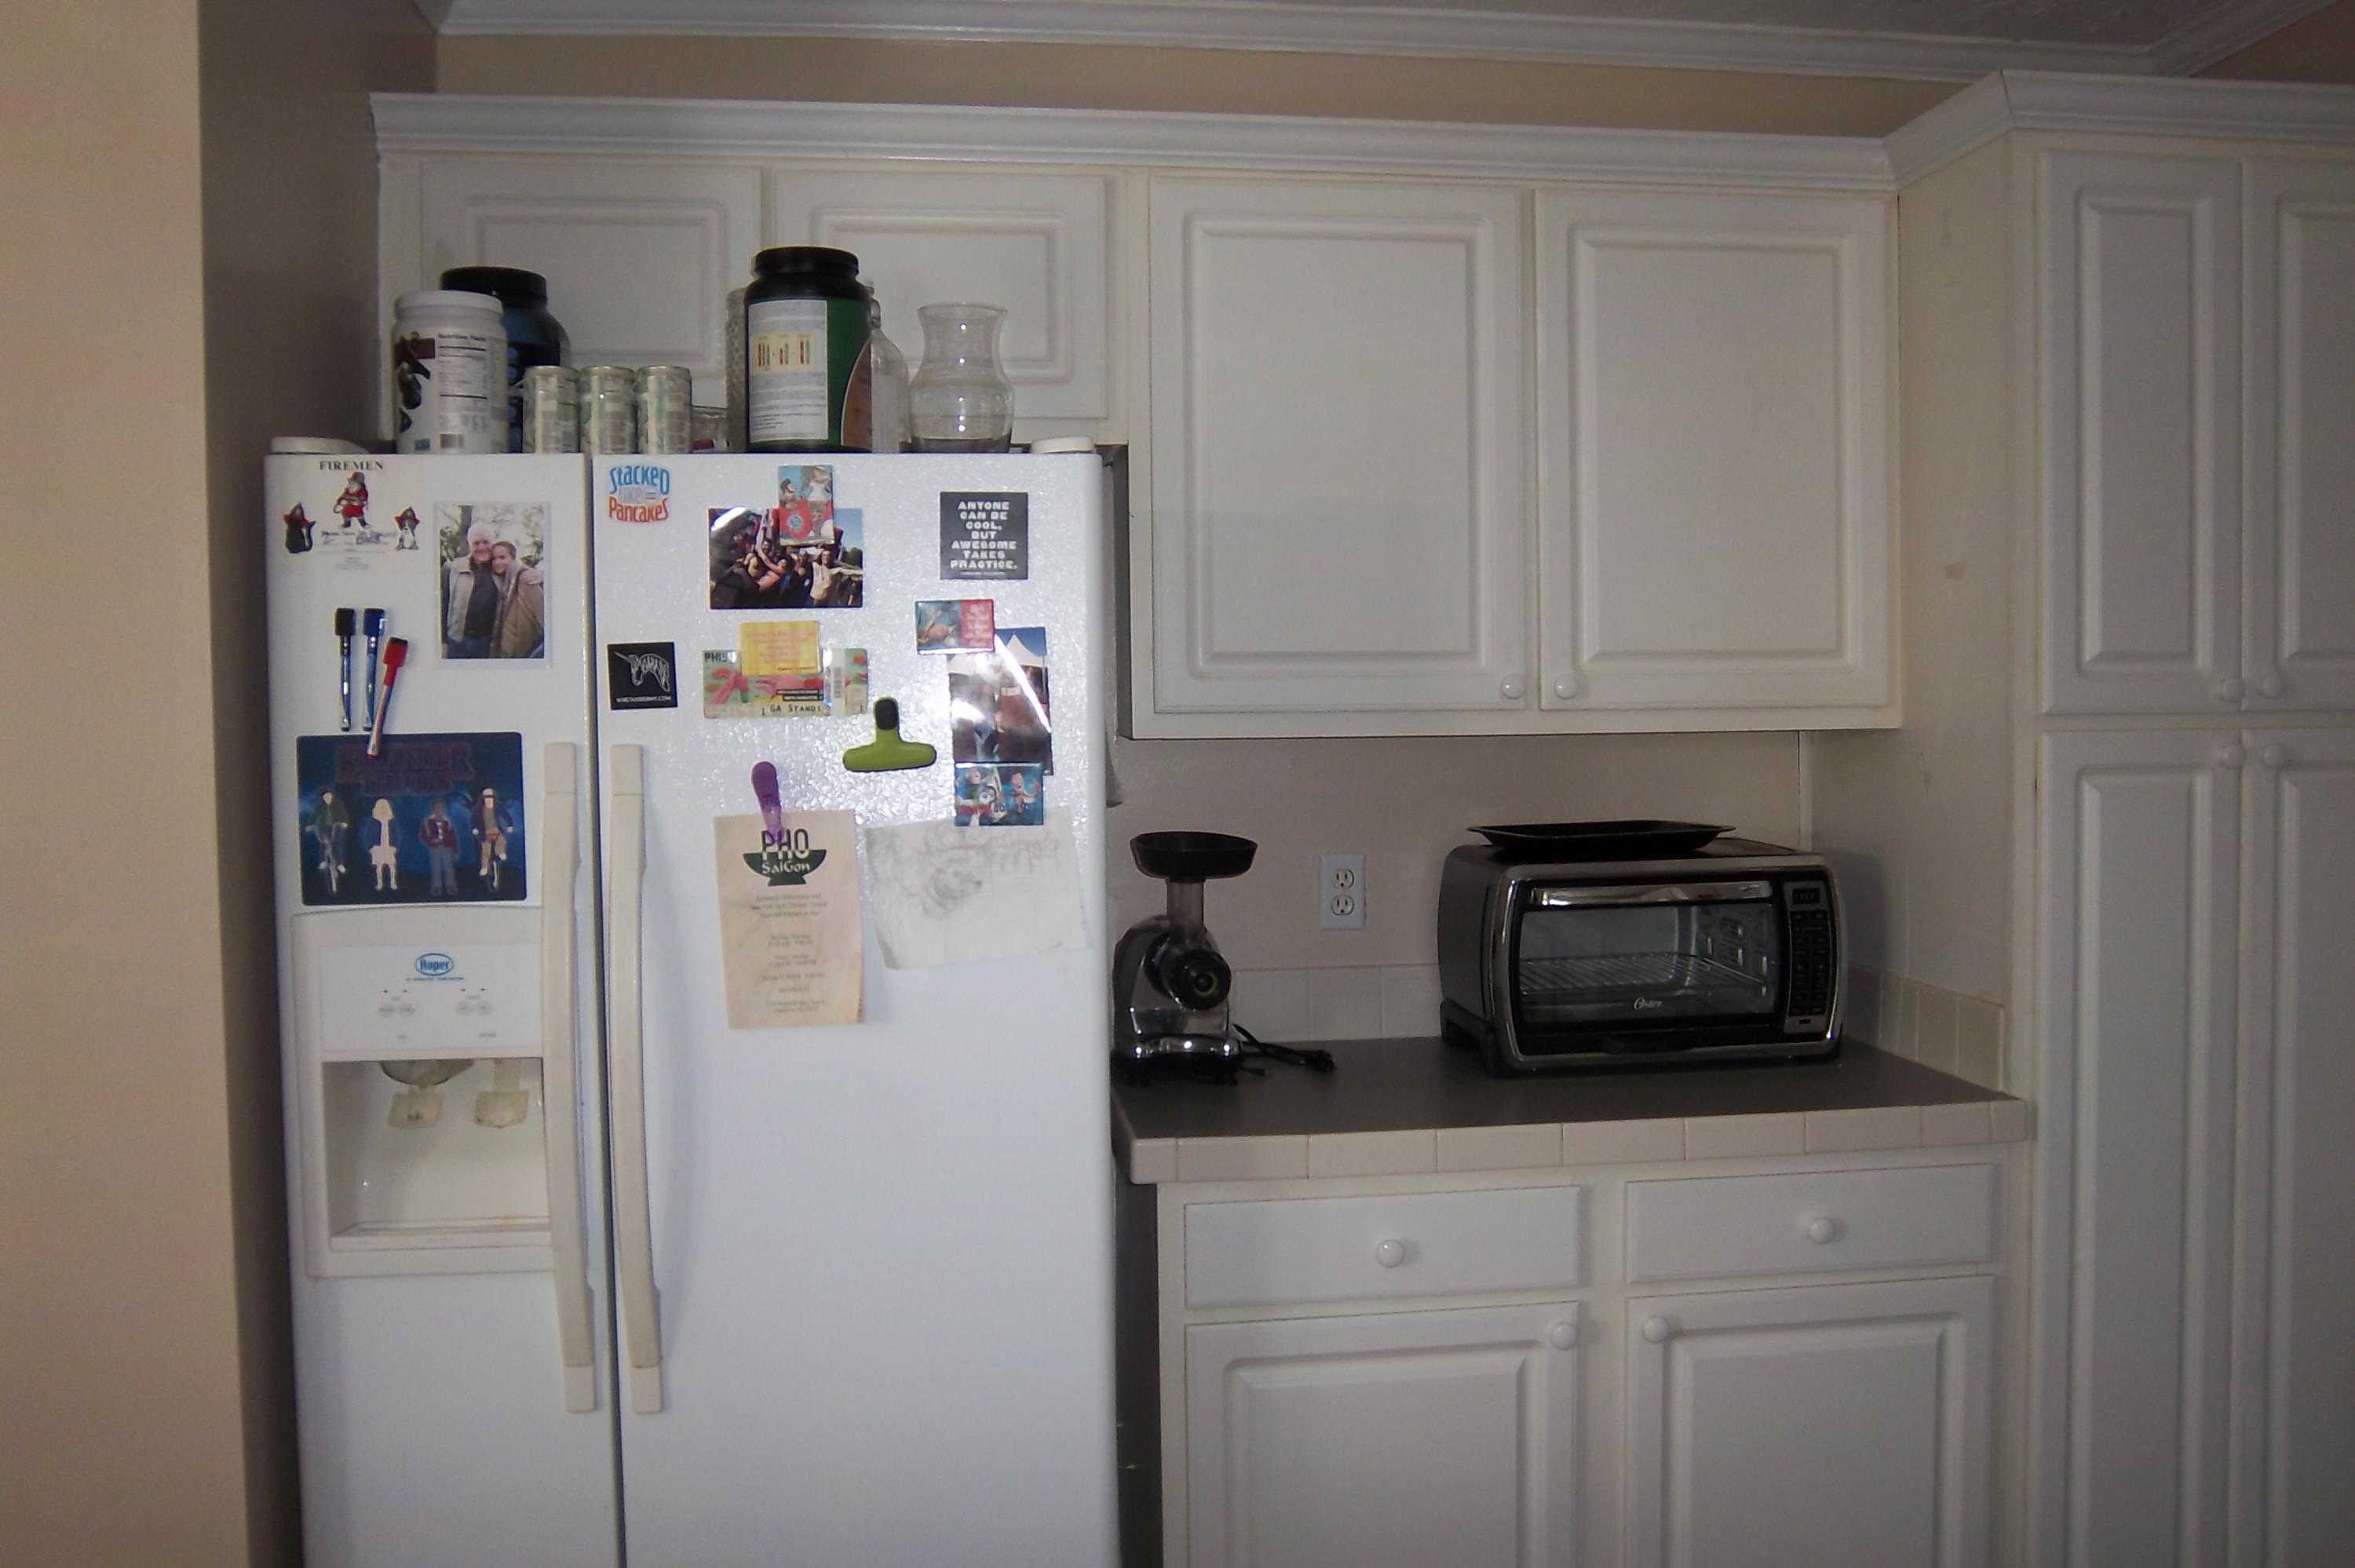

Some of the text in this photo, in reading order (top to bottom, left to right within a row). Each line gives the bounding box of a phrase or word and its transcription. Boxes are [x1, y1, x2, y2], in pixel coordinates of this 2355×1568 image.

[319, 461, 383, 470] FIREMEN
[958, 501, 1010, 510] ANYONE
[966, 521, 1002, 531] COOL,
[971, 531, 997, 540] BUT
[951, 540, 1017, 549] AWESOME
[962, 550, 1006, 560] TAKES
[950, 560, 1017, 569] PRACTICE.
[761, 829, 809, 859] PHO
